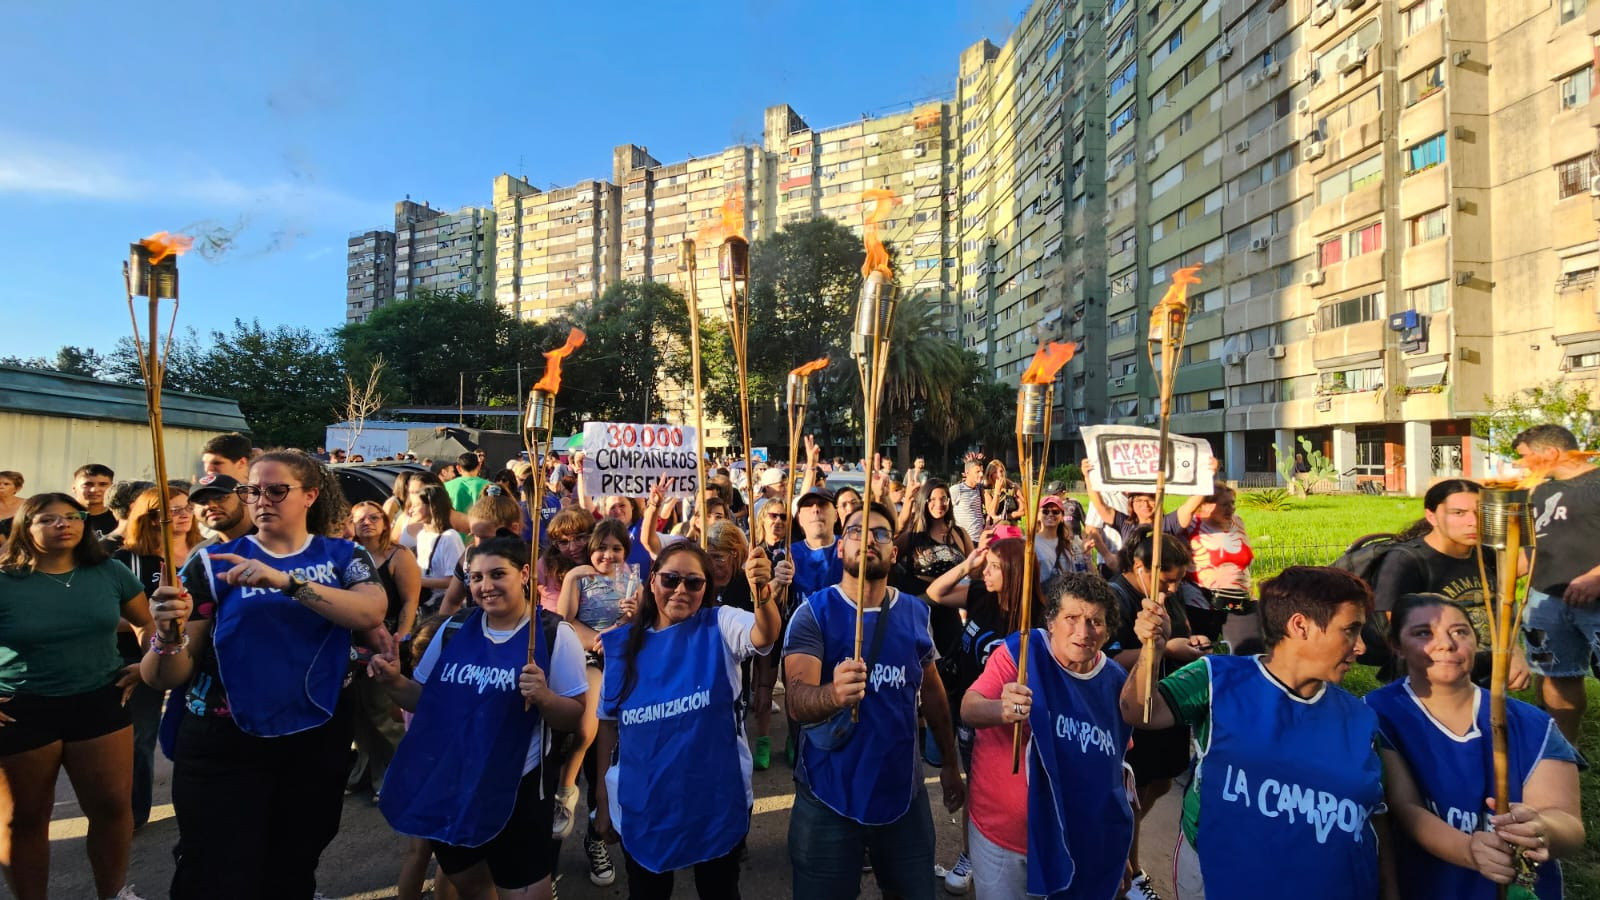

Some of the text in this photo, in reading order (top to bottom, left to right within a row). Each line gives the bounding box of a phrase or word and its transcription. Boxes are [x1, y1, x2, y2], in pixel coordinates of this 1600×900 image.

[607, 425, 683, 448] 30.000
[596, 448, 697, 470] COMPAÑEROS
[1114, 460, 1159, 476] TELE
[440, 663, 458, 683] LA
[622, 685, 710, 725] ORGANIZACIÓN
[1223, 765, 1250, 807] LA
